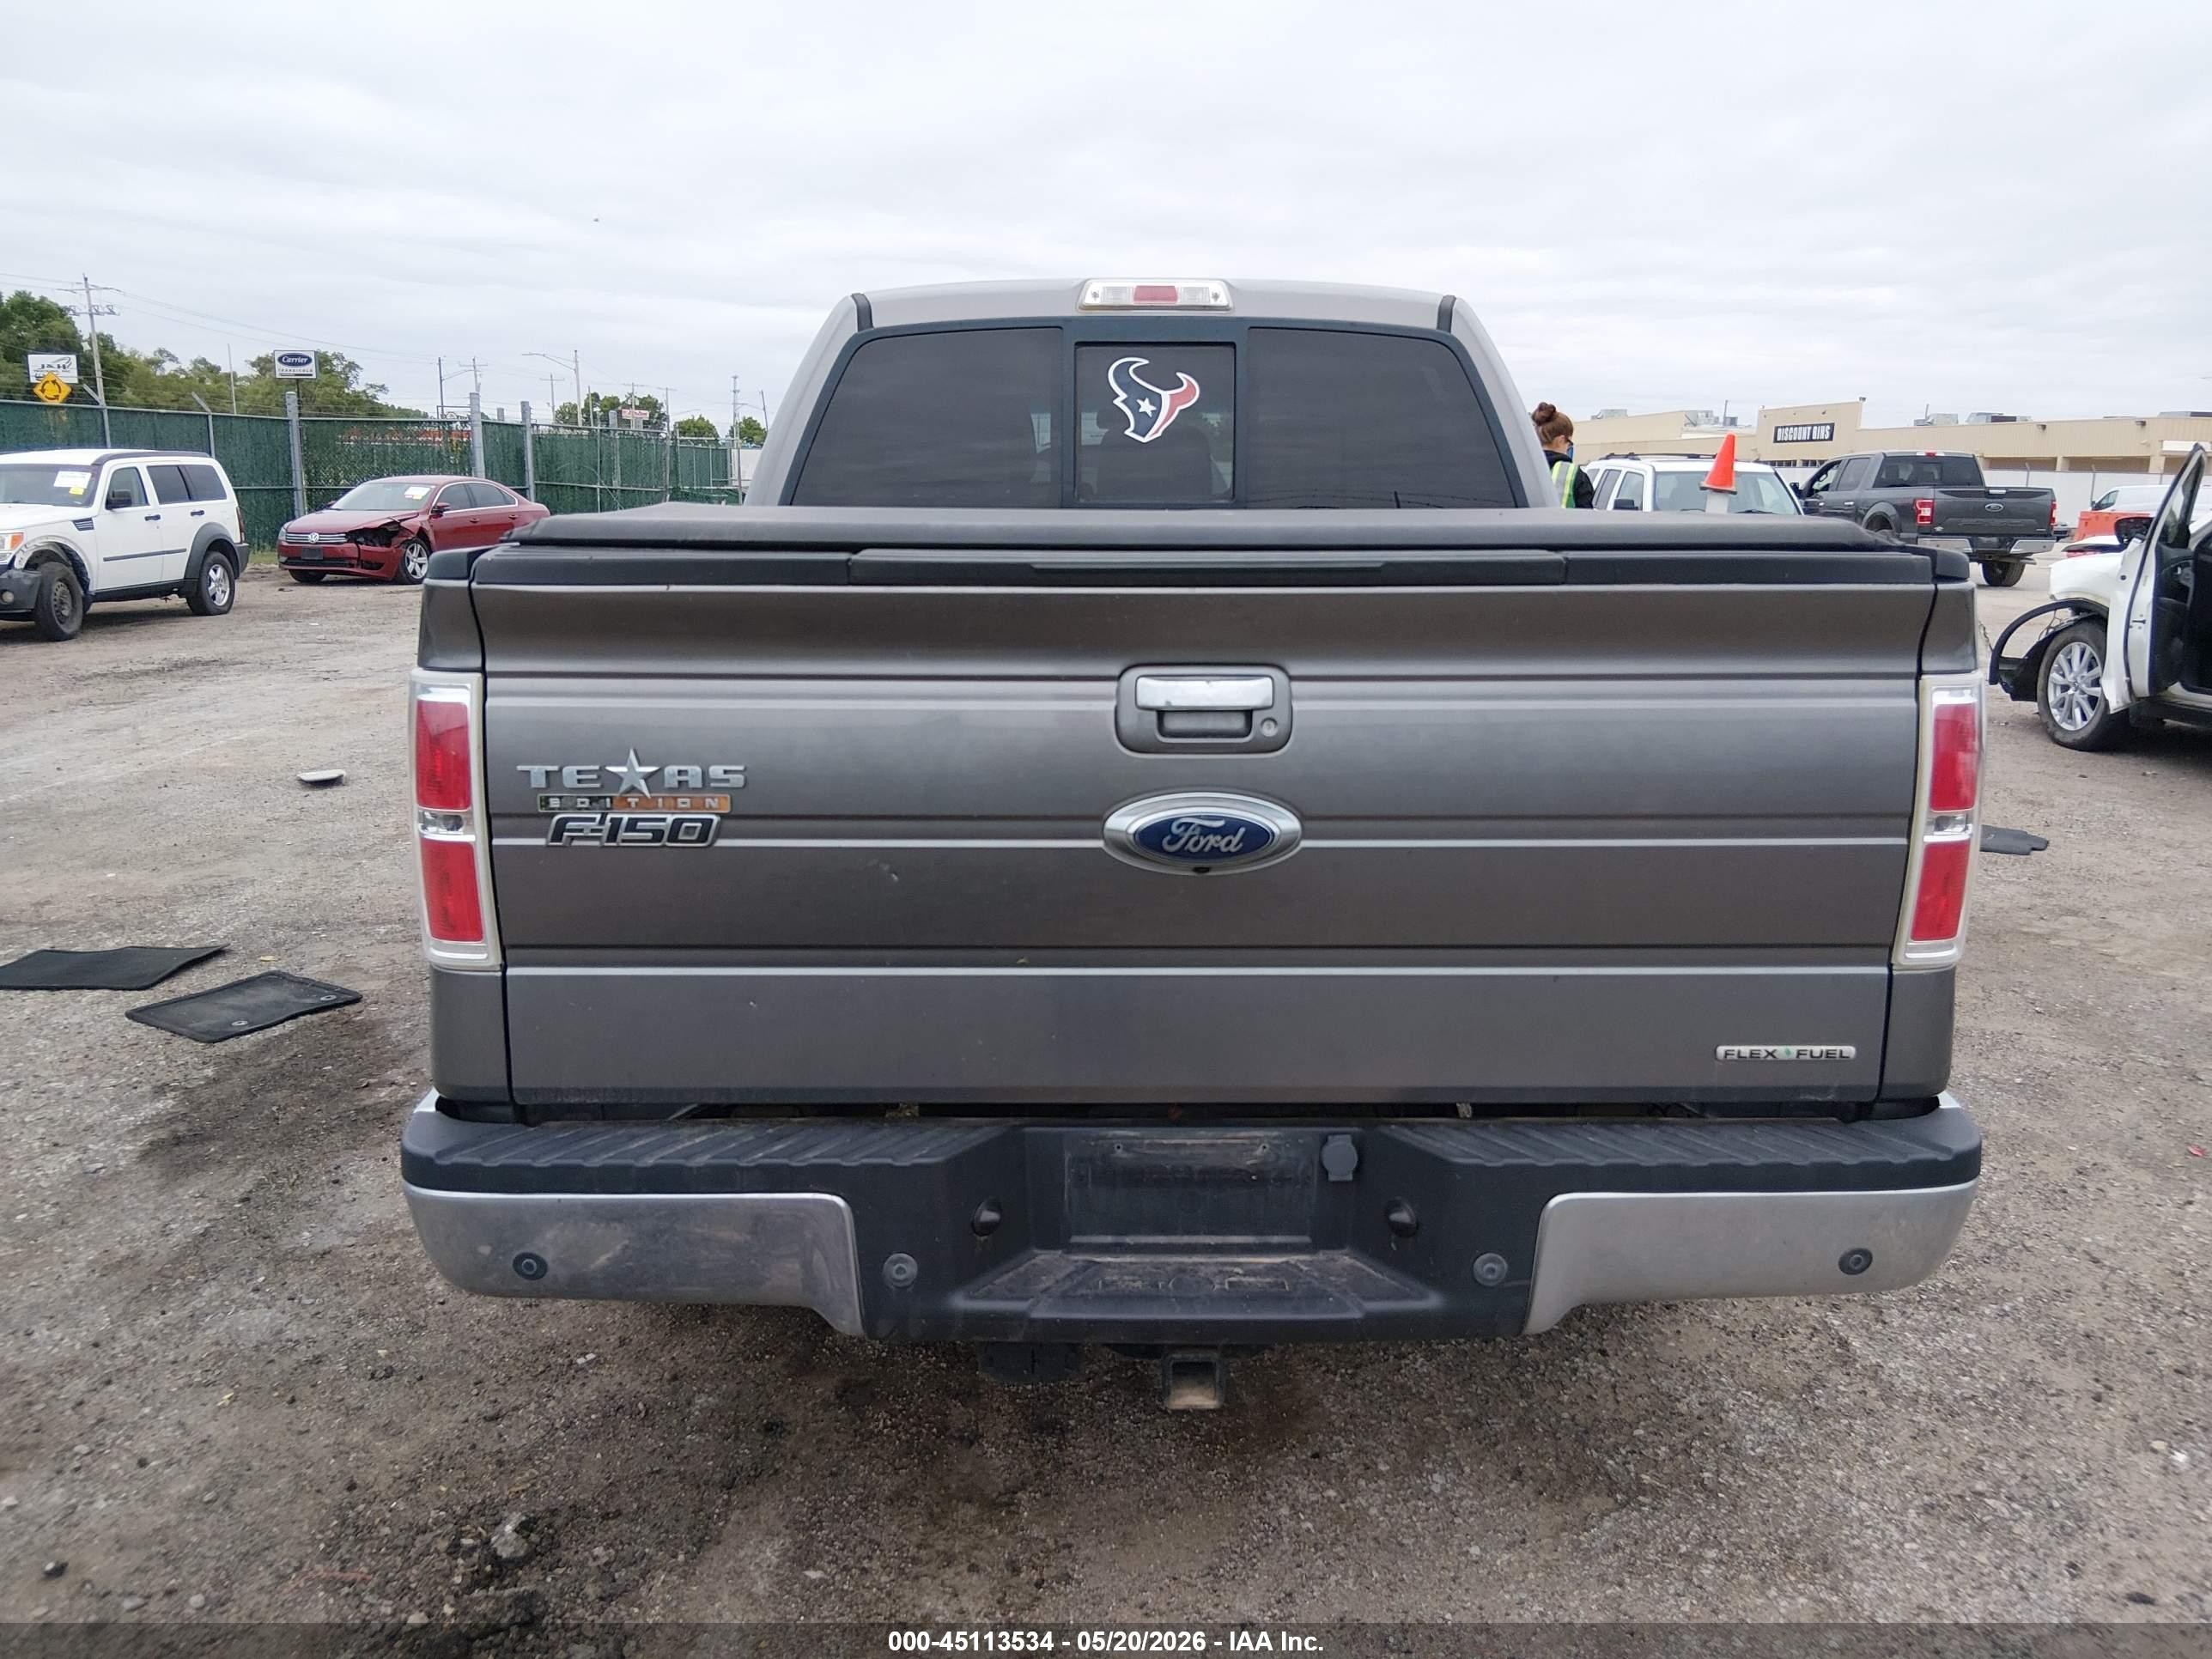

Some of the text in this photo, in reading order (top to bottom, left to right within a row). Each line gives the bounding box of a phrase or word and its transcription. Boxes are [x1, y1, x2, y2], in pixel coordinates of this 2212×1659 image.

[1777, 425, 1831, 441] DISCOUNT BINS
[549, 798, 720, 808] EDITION
[1162, 817, 1246, 853] Ford
[1724, 1049, 1850, 1059] FLEX FUEL
